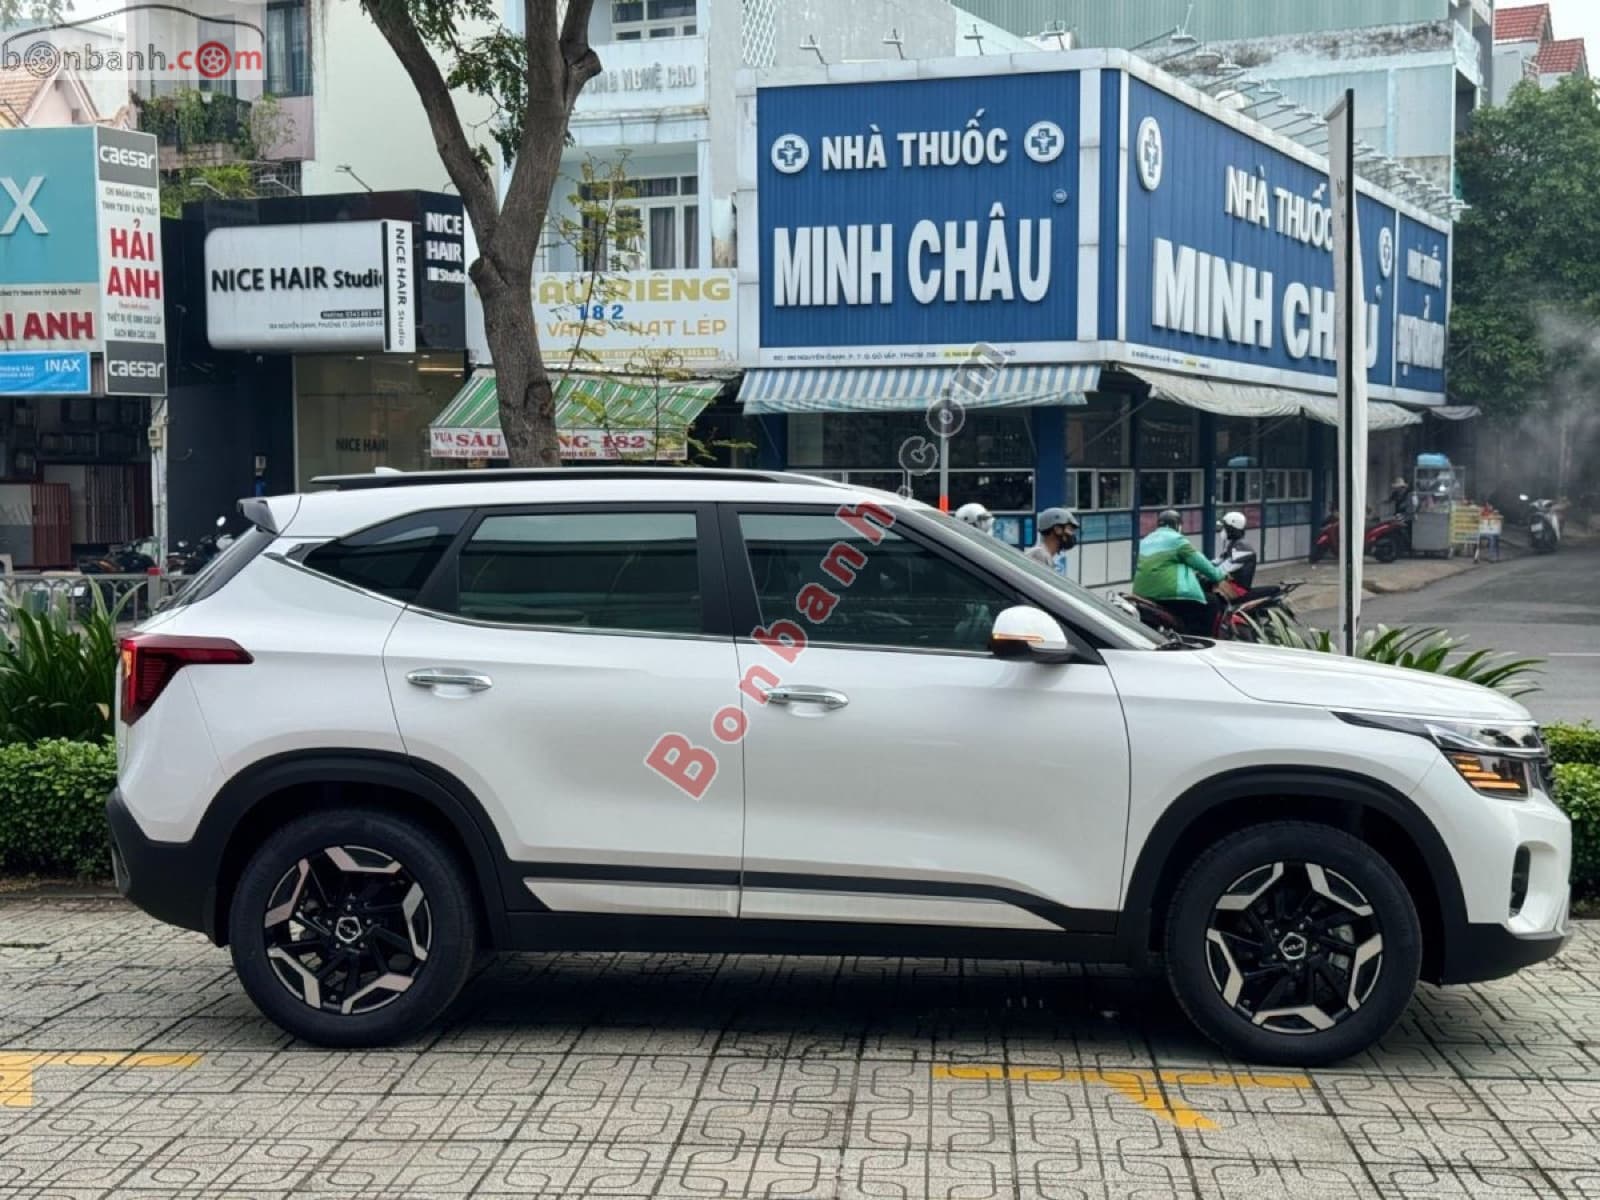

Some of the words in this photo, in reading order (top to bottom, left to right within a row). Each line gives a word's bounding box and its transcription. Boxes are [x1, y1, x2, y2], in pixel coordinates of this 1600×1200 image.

[667, 65, 696, 88] CAO
[822, 124, 887, 170] NHÀ
[897, 108, 1008, 168] THUỐC
[99, 145, 155, 169] caesar
[1224, 165, 1270, 228] NHÀ
[425, 212, 463, 235] NICE
[110, 218, 155, 262] HẢI
[395, 228, 406, 265] NICE
[425, 240, 463, 262] HAIR
[774, 223, 893, 306] MINH
[908, 201, 1052, 304] CHÂU
[107, 265, 161, 300] ANH
[211, 268, 265, 292] NICE
[270, 266, 328, 290] HAIR
[397, 268, 408, 305] HAIR
[1152, 238, 1273, 349] MINH
[1283, 281, 1379, 368] CHU
[23, 311, 95, 341] ANH
[683, 313, 727, 336] LÉP
[45, 359, 81, 373] INAX
[108, 360, 165, 377] caesar
[336, 437, 361, 451] NICE
